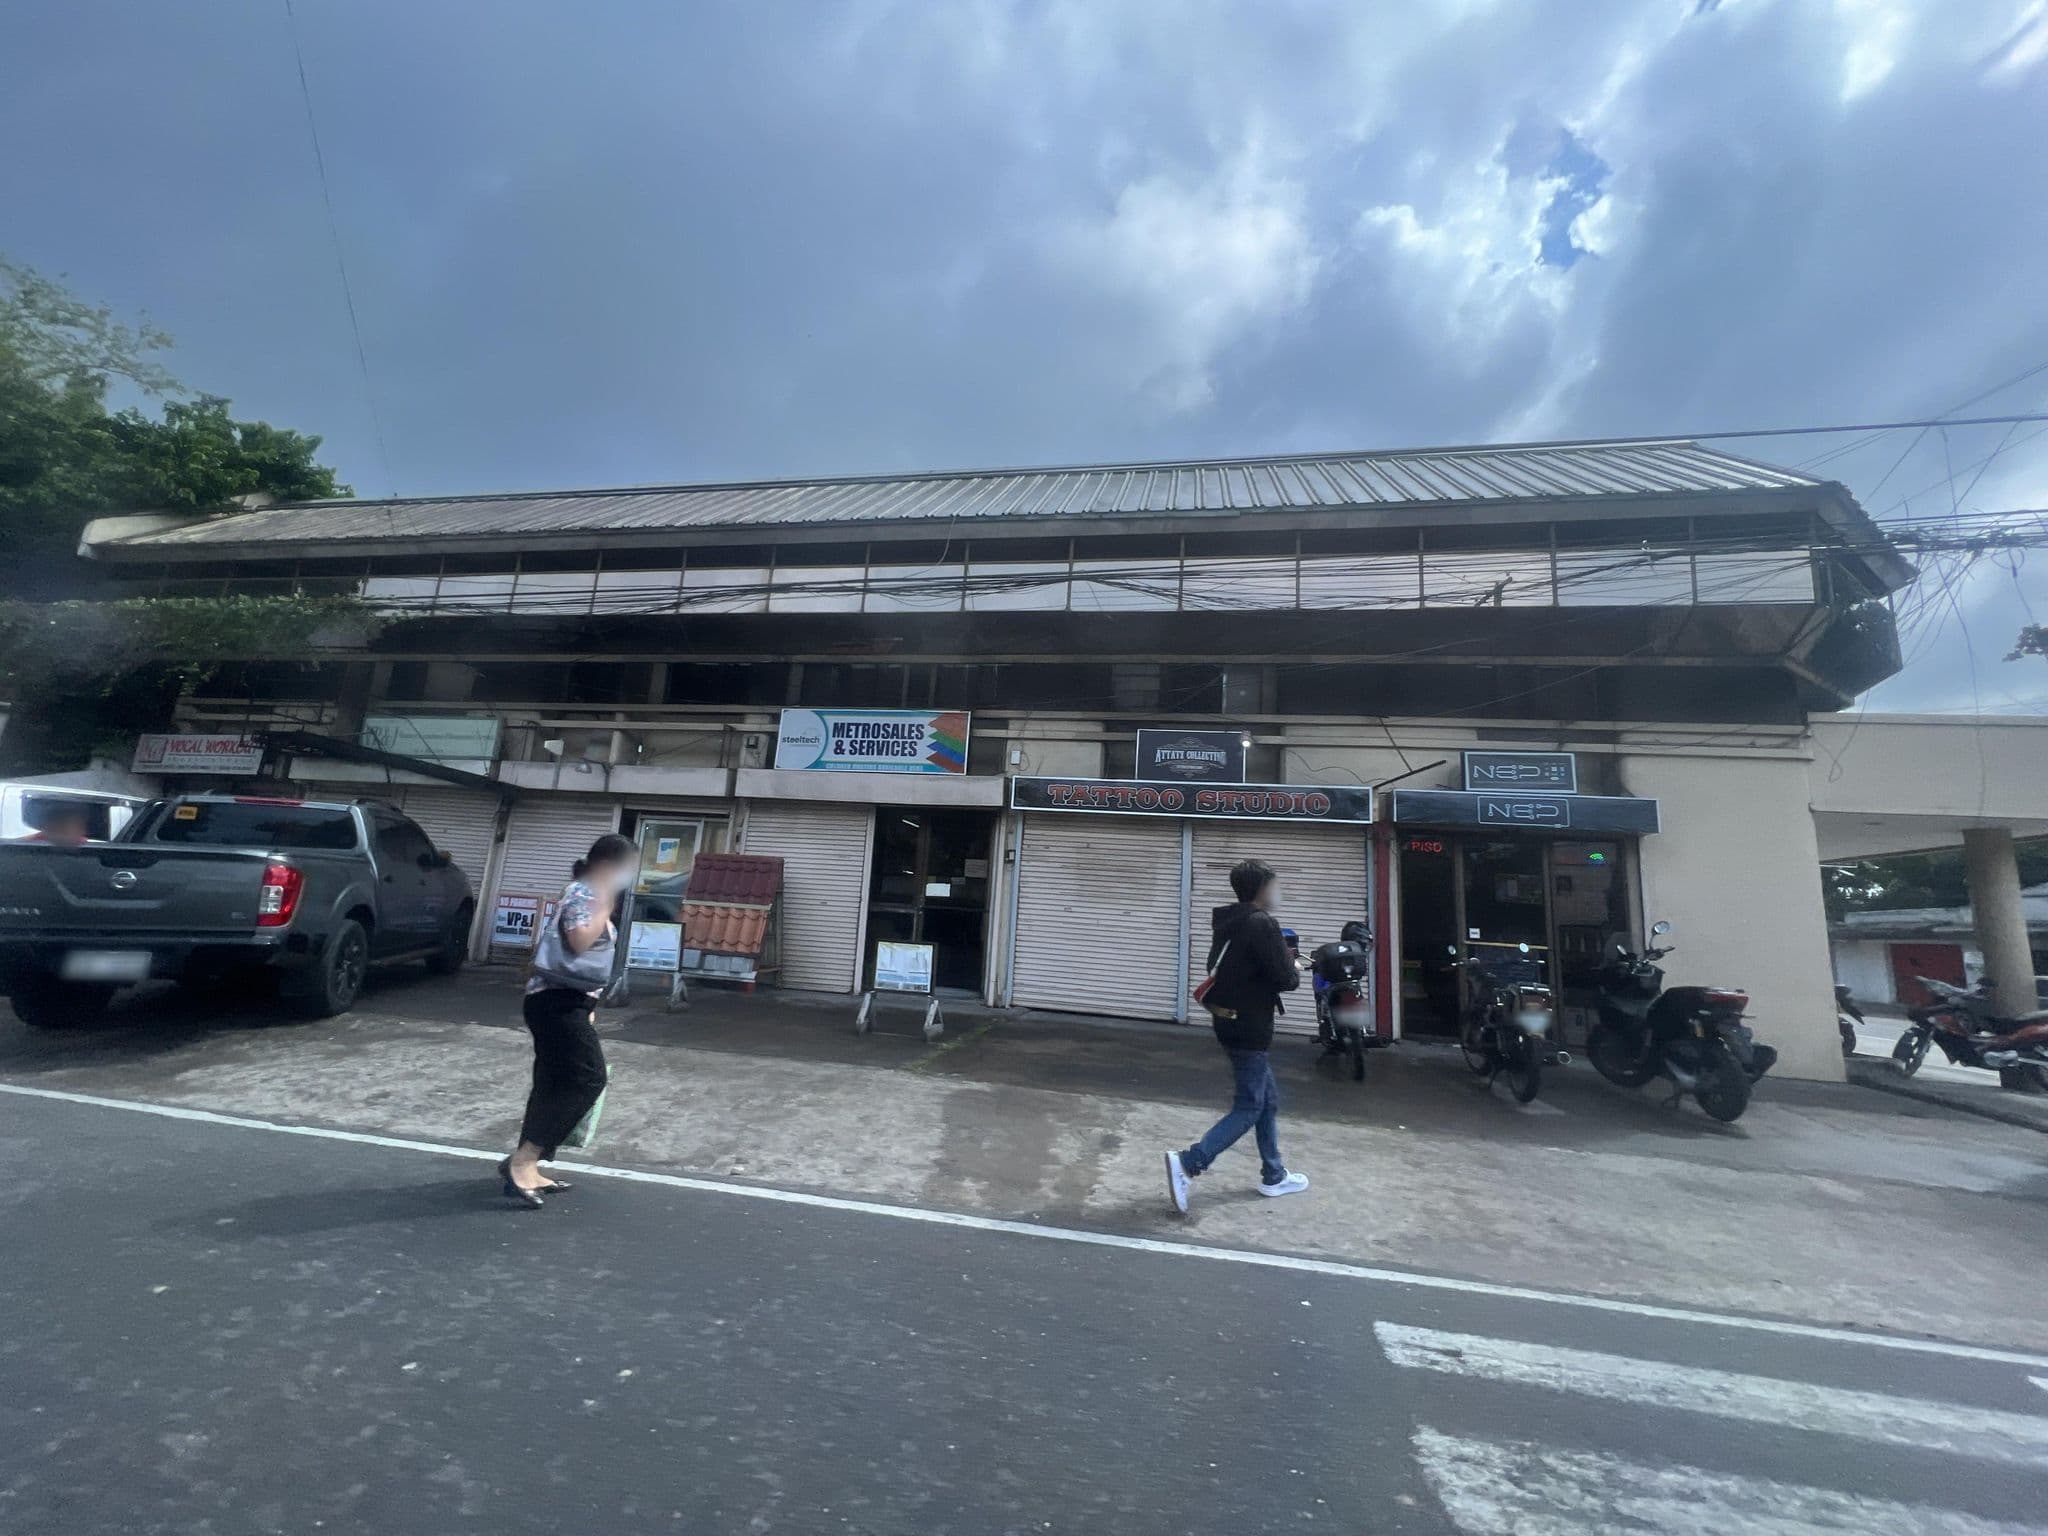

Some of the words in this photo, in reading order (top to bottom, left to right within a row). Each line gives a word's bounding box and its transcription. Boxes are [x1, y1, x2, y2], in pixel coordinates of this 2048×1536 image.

[782, 735, 820, 744] steeltech
[832, 722, 925, 740] METROSALES
[833, 740, 846, 756] &
[848, 740, 918, 757] SERVICES
[1047, 784, 1184, 811] TATTOO
[1195, 790, 1331, 816] STUDIO
